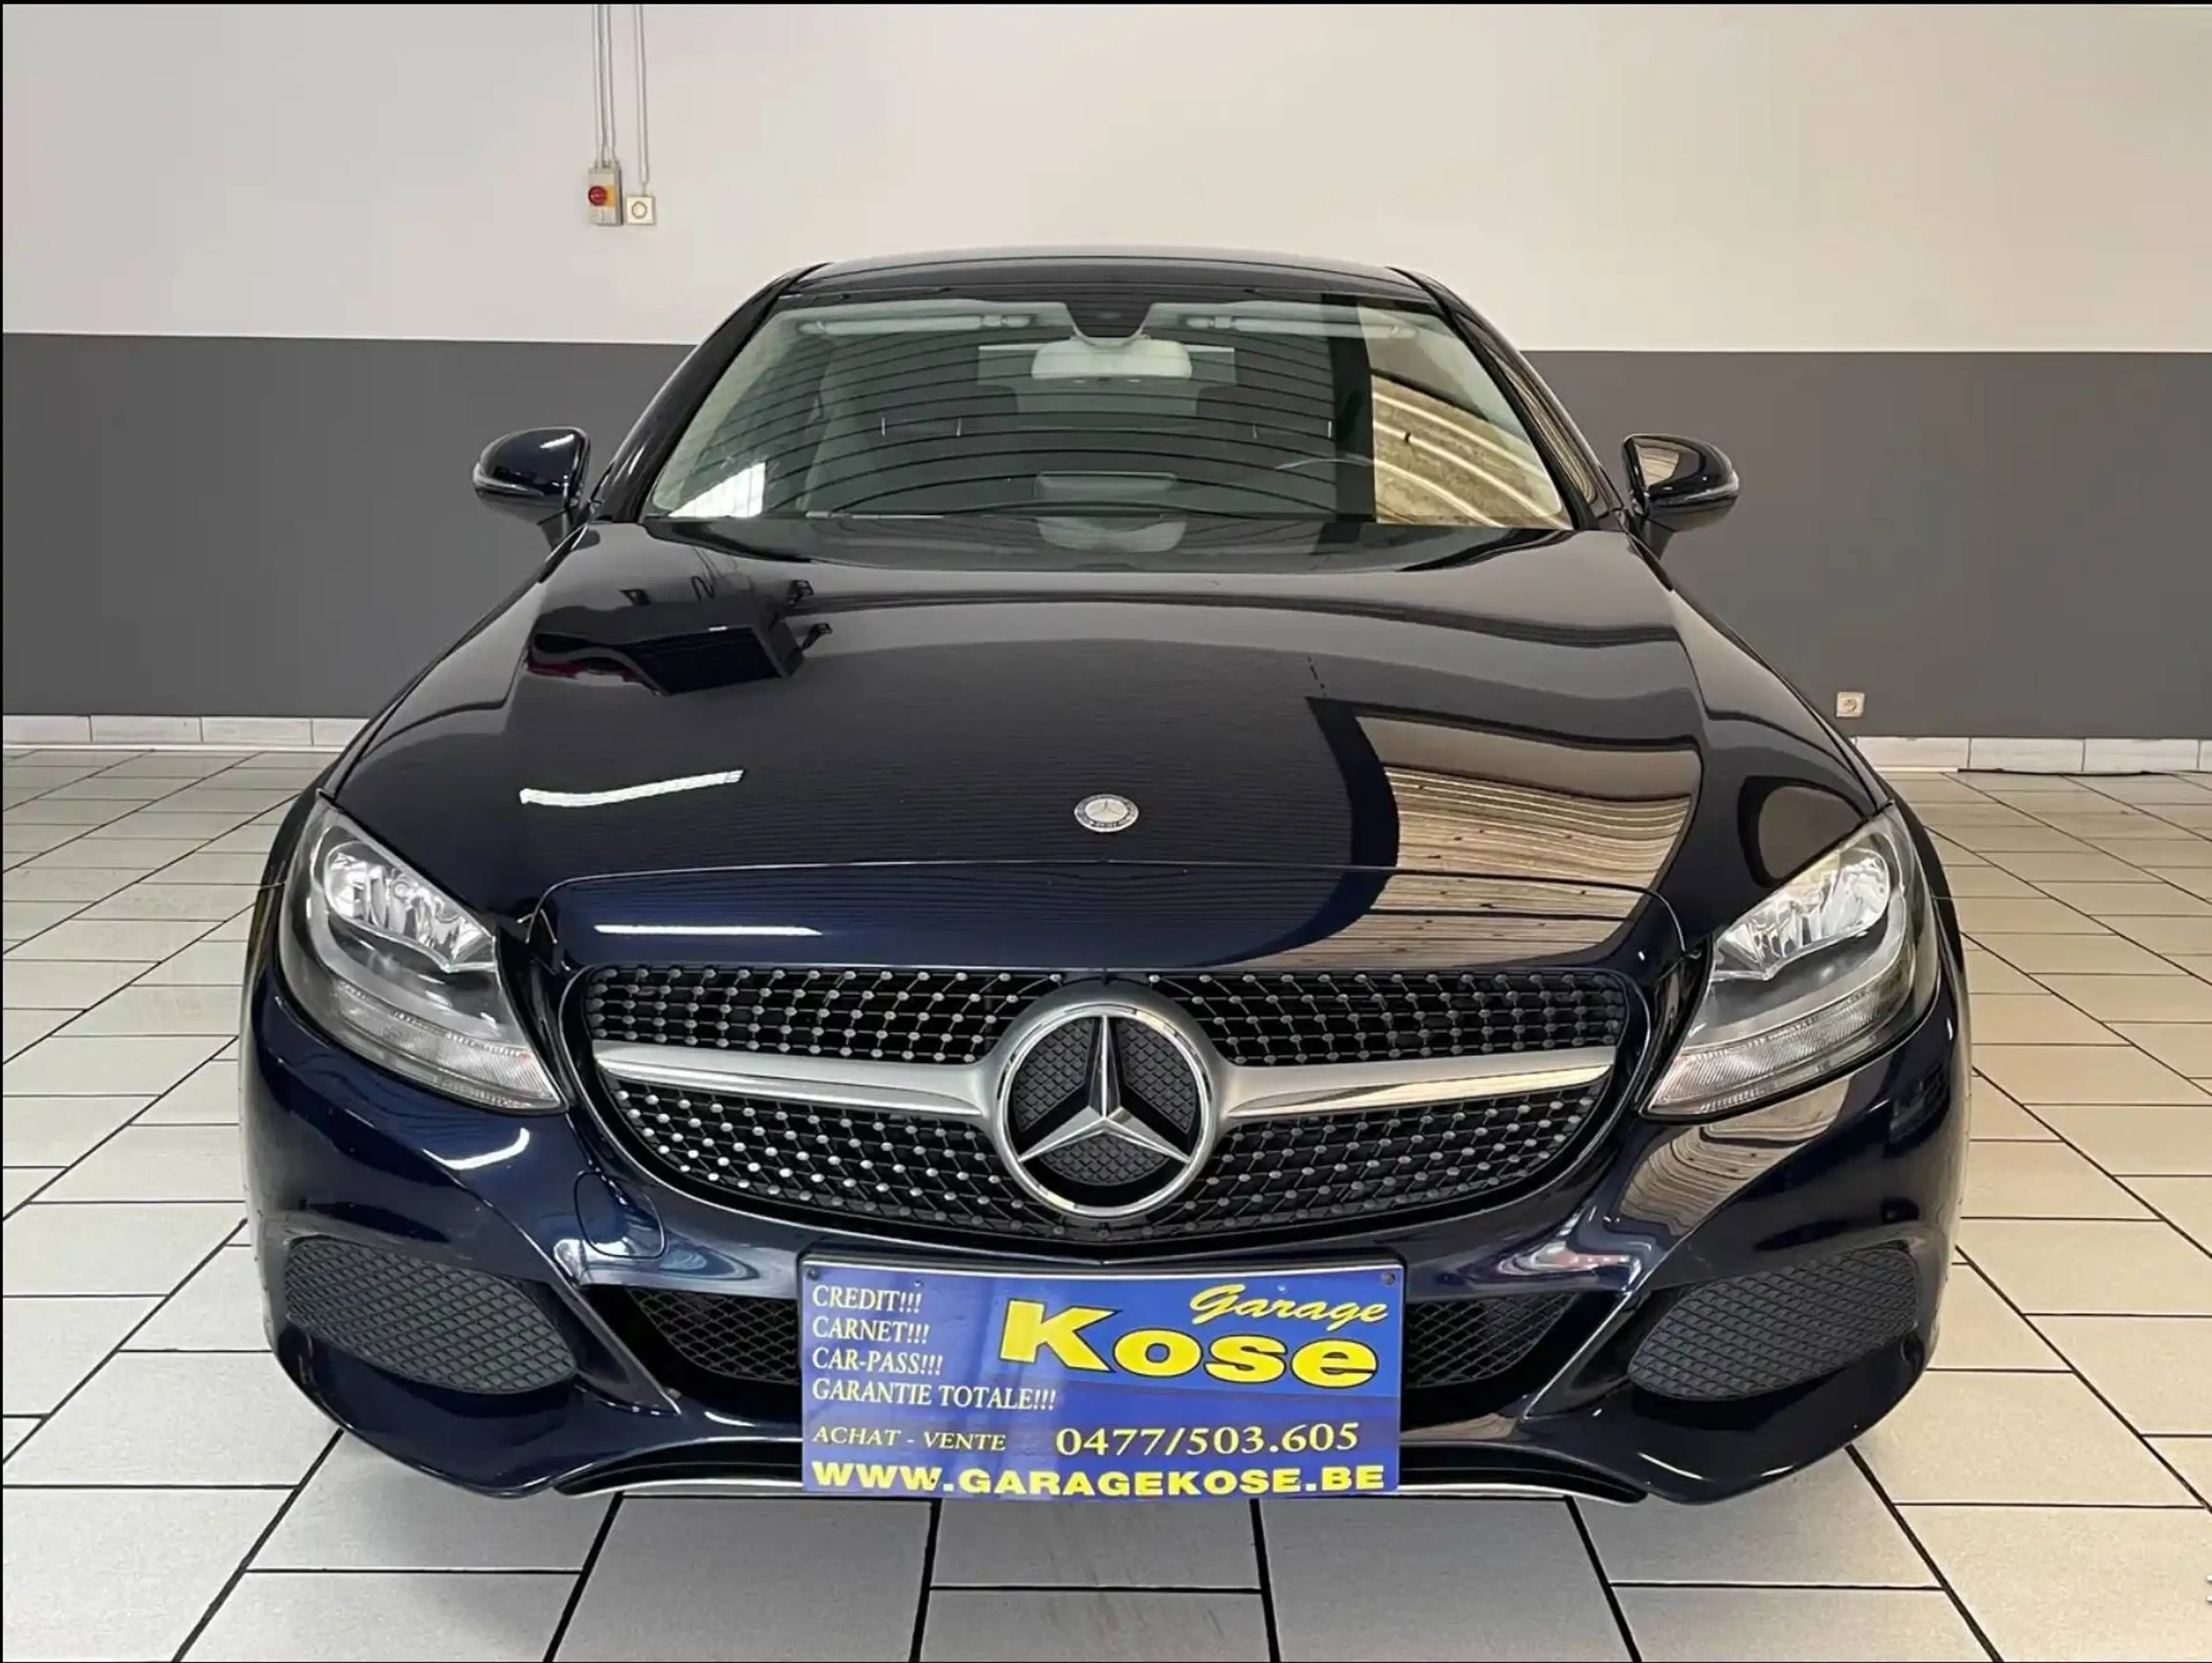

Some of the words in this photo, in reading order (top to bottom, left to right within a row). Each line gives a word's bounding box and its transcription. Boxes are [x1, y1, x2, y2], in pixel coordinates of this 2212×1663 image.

[812, 1284, 922, 1314] CREDIT!!!
[1189, 1283, 1388, 1330] Garage
[812, 1315, 930, 1344] CARNET!!!
[999, 1299, 1379, 1388] Kose
[812, 1347, 943, 1376] CAR-PASS!!!
[812, 1378, 932, 1405] GARANTIE
[938, 1385, 1057, 1411] TOTALE!!!
[812, 1425, 902, 1446] ACHAT
[923, 1430, 1007, 1452] VENTE
[1055, 1422, 1360, 1456] 0477/503.605
[811, 1461, 1385, 1496] WWW.GARAGEKOSE.BE
